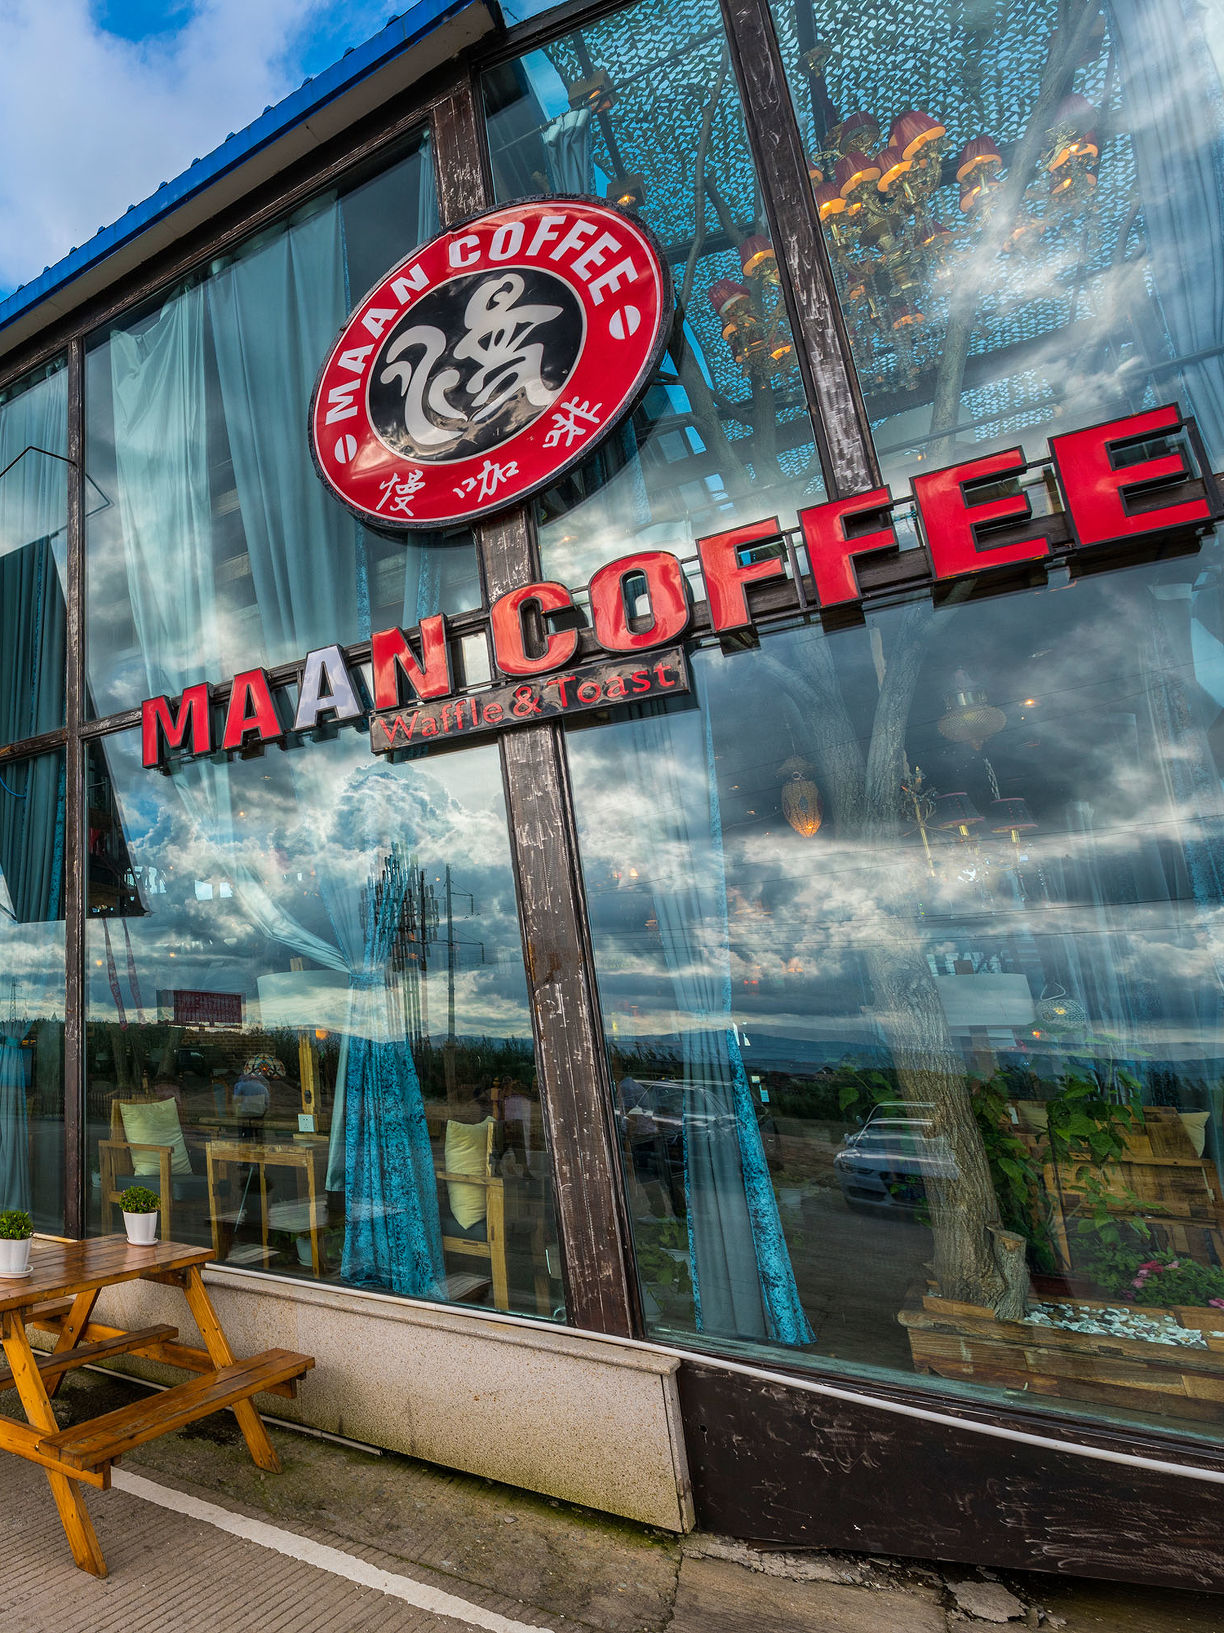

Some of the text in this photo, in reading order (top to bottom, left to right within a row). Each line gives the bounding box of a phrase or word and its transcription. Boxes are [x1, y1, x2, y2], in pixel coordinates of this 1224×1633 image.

[325, 215, 639, 426] MAAN COFFEE
[142, 404, 1212, 769] MAAN COFFEE
[379, 662, 676, 744] Waffle & Toast
